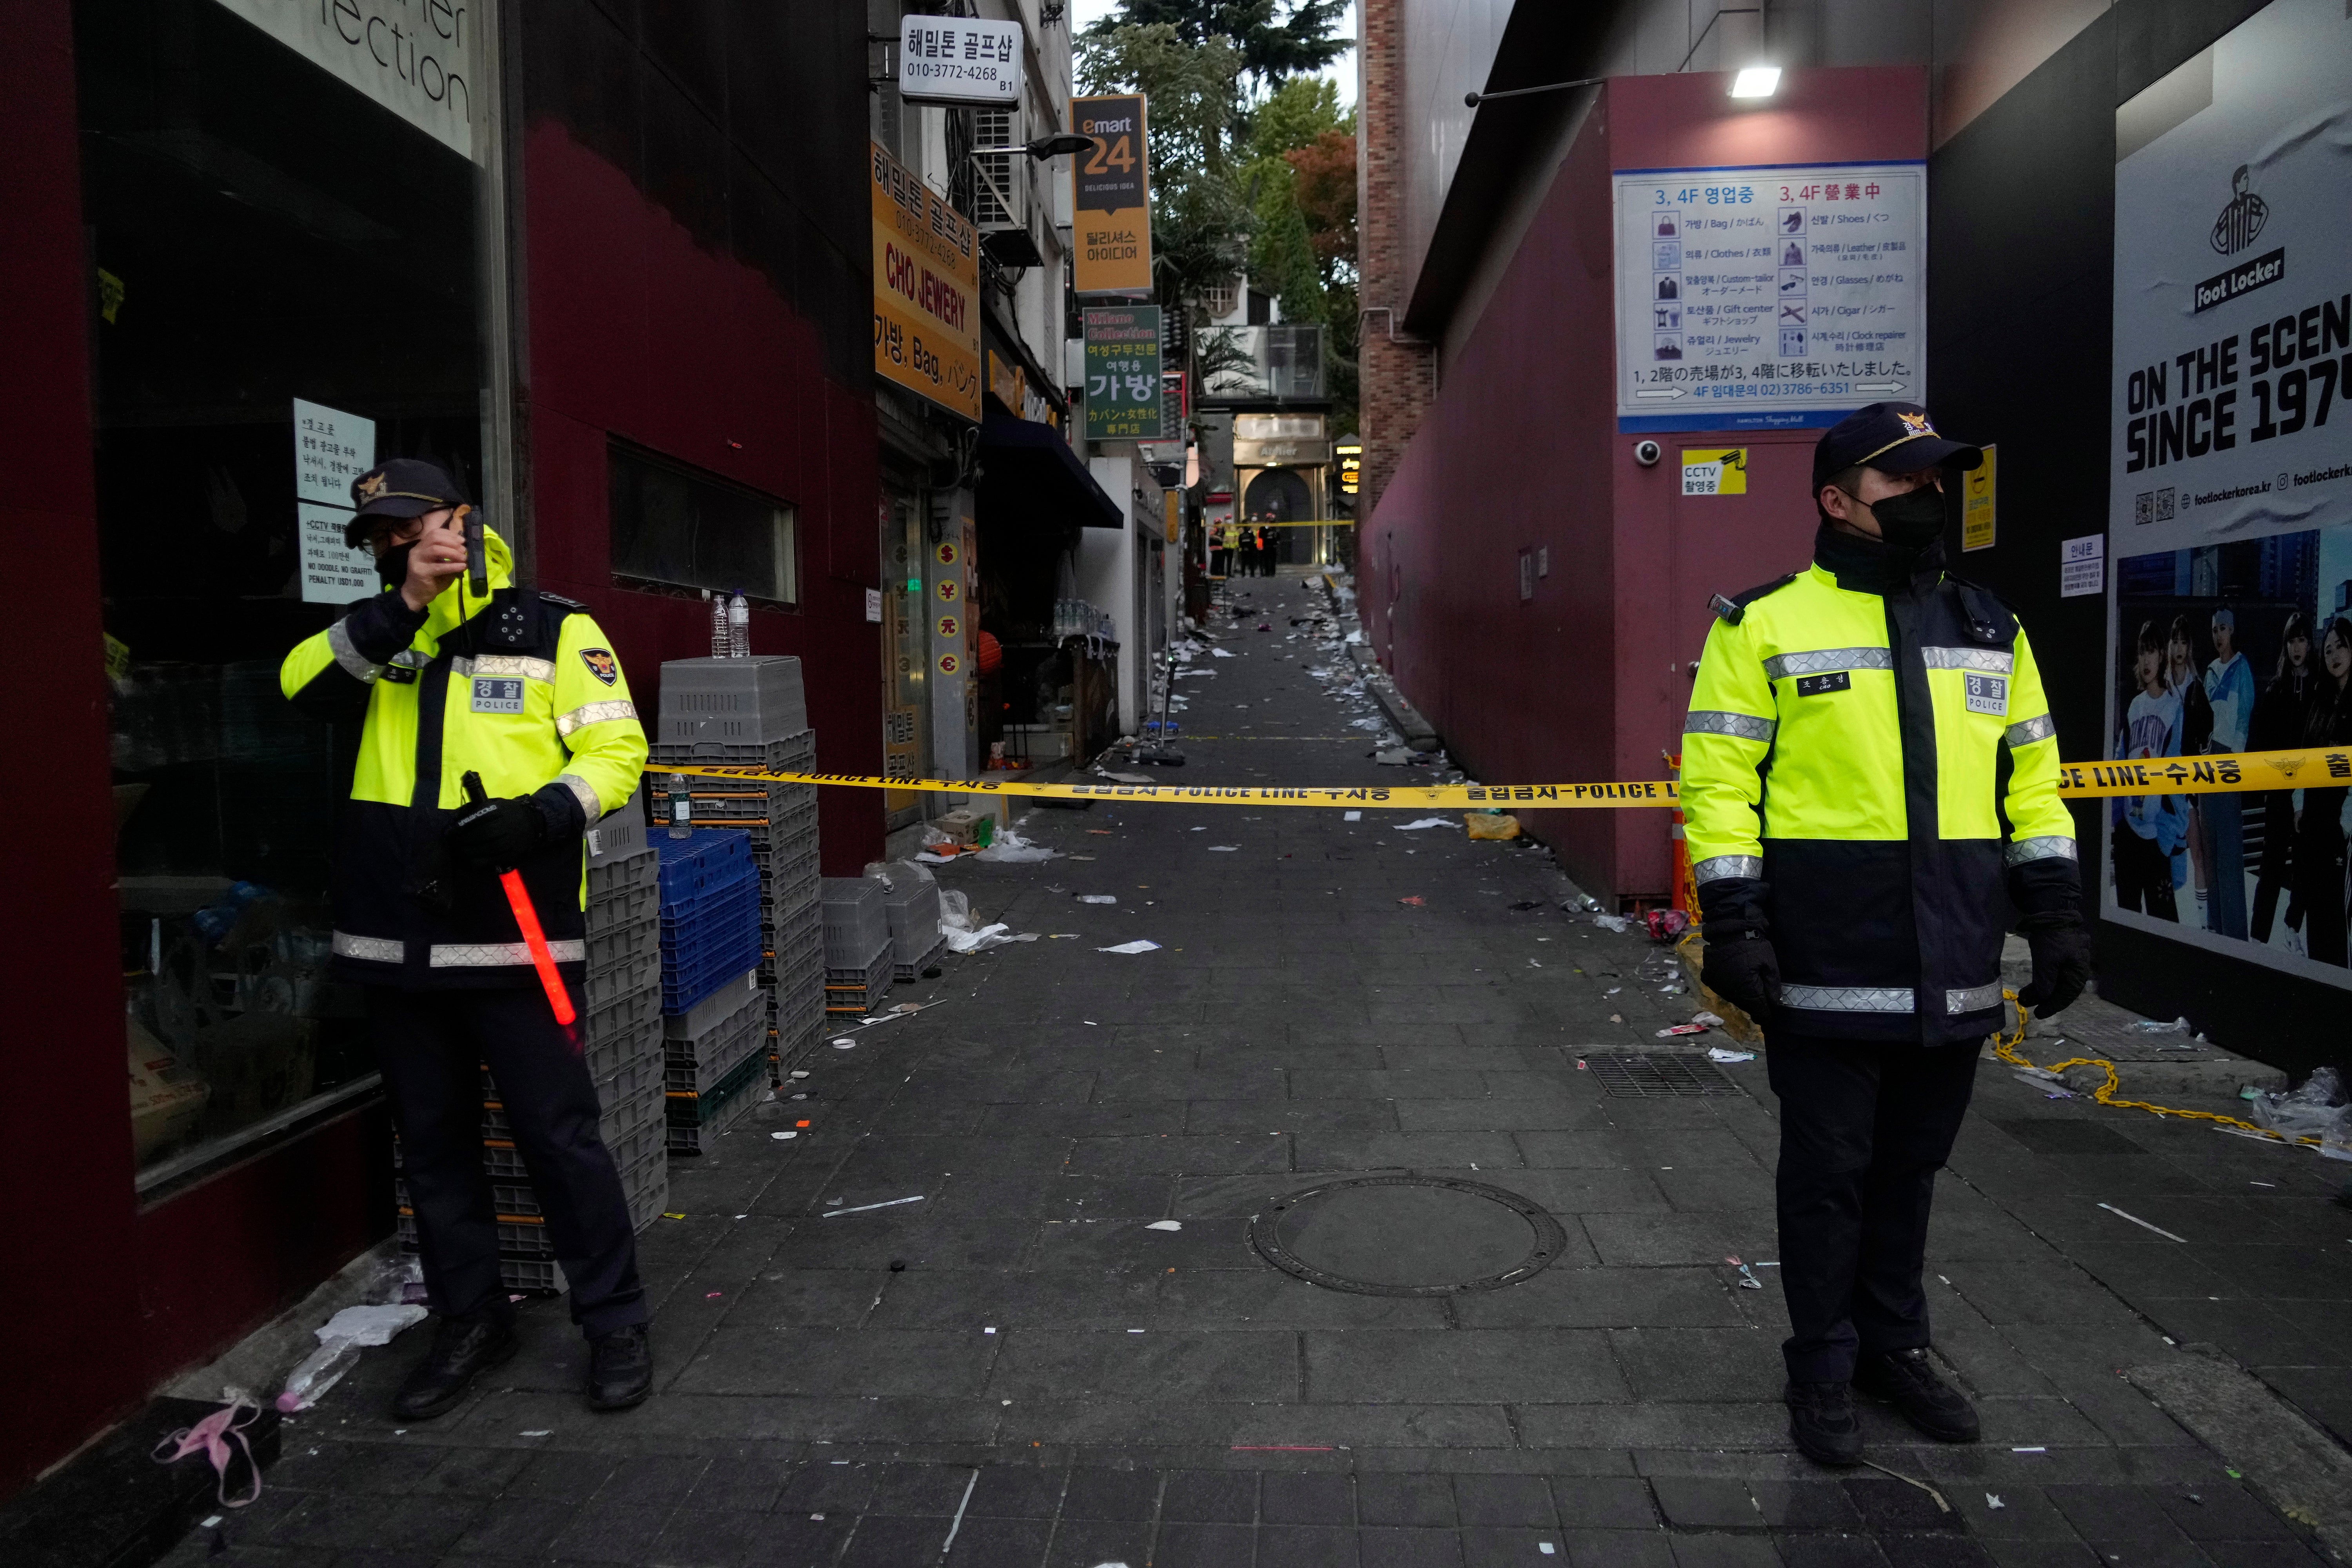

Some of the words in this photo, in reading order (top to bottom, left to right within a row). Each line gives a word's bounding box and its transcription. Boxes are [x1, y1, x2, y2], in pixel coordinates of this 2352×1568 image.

[908, 29, 956, 58] 해밀톤
[964, 32, 1012, 63] 골프샵
[908, 63, 997, 81] 010-3772-4268
[1000, 81, 1012, 91] B1
[1082, 117, 1132, 134] emart
[1084, 135, 1136, 175] 24
[1085, 184, 1118, 192] DELICIOUS
[1677, 189, 1699, 203] 4F
[1705, 186, 1754, 205] 영업중
[1799, 185, 1820, 200] 4F
[873, 149, 923, 221] 해밀톤
[929, 196, 972, 260] 골프샵
[1686, 220, 1701, 229] 가방
[1711, 220, 1727, 229] Bag
[1811, 216, 1828, 225] 신발
[1838, 215, 1864, 223] Shoes
[895, 209, 956, 270] 010-3772-4268
[1086, 230, 1136, 246] 딜리셔스
[1087, 246, 1137, 261] 아이디어
[1710, 249, 1744, 258] Clothes
[885, 241, 915, 301] CHO
[918, 266, 965, 334] JEWERY
[2198, 279, 2227, 308] Foot
[2231, 258, 2281, 294] Locker
[1088, 327, 1155, 340] Collection
[875, 314, 908, 368] 가방,
[912, 335, 943, 385] Bag,
[1087, 344, 1157, 357] 여성구두전문
[1106, 360, 1141, 372] 여행용
[2128, 360, 2167, 415] ON
[2176, 334, 2238, 399] THE
[1089, 374, 1156, 401] 가방
[1693, 386, 1709, 397] 4F
[1711, 385, 1757, 398] 임대문의
[1760, 382, 1849, 396] 02)3786-6351
[2127, 389, 2237, 474] SINCE
[1685, 467, 1717, 477] CCTV
[1685, 480, 1715, 493] 촬영중
[2194, 481, 2271, 506] footlockerkorea.kr
[2294, 464, 2352, 487] footlockerk
[350, 567, 372, 576] GRAFFITI
[309, 575, 335, 585] PENALTY
[338, 578, 364, 587] USD1,000
[941, 619, 955, 633] 元
[476, 701, 518, 710] POLICE
[1970, 698, 2002, 711] POLICE
[887, 712, 913, 744] 해밀톤
[1466, 783, 1657, 801] 출입금지-POLICE
